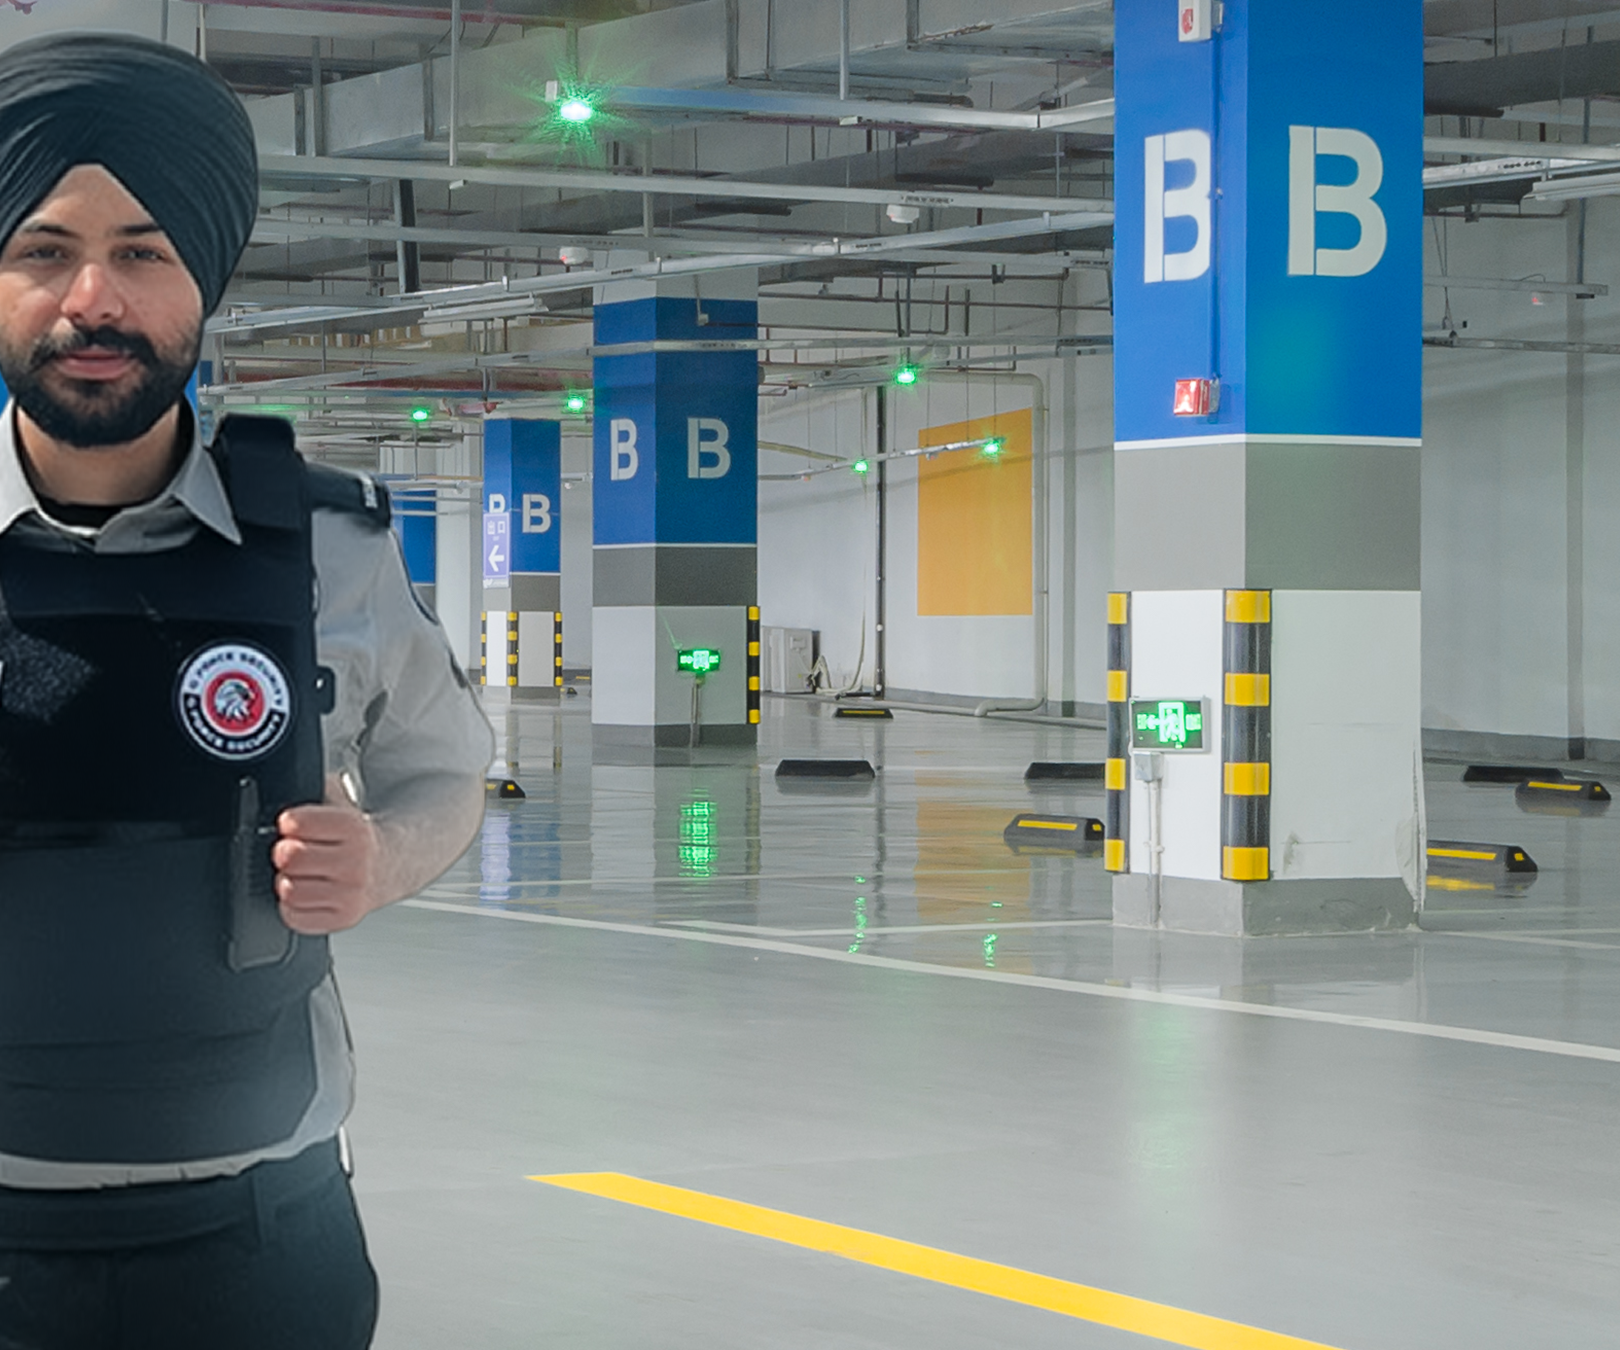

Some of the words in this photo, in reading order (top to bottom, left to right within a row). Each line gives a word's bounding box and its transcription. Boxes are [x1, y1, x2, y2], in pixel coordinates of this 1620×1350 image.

[1144, 128, 1211, 283] B
[1287, 125, 1387, 277] B
[610, 418, 639, 481] B
[687, 418, 731, 479] B
[522, 494, 551, 533] B
